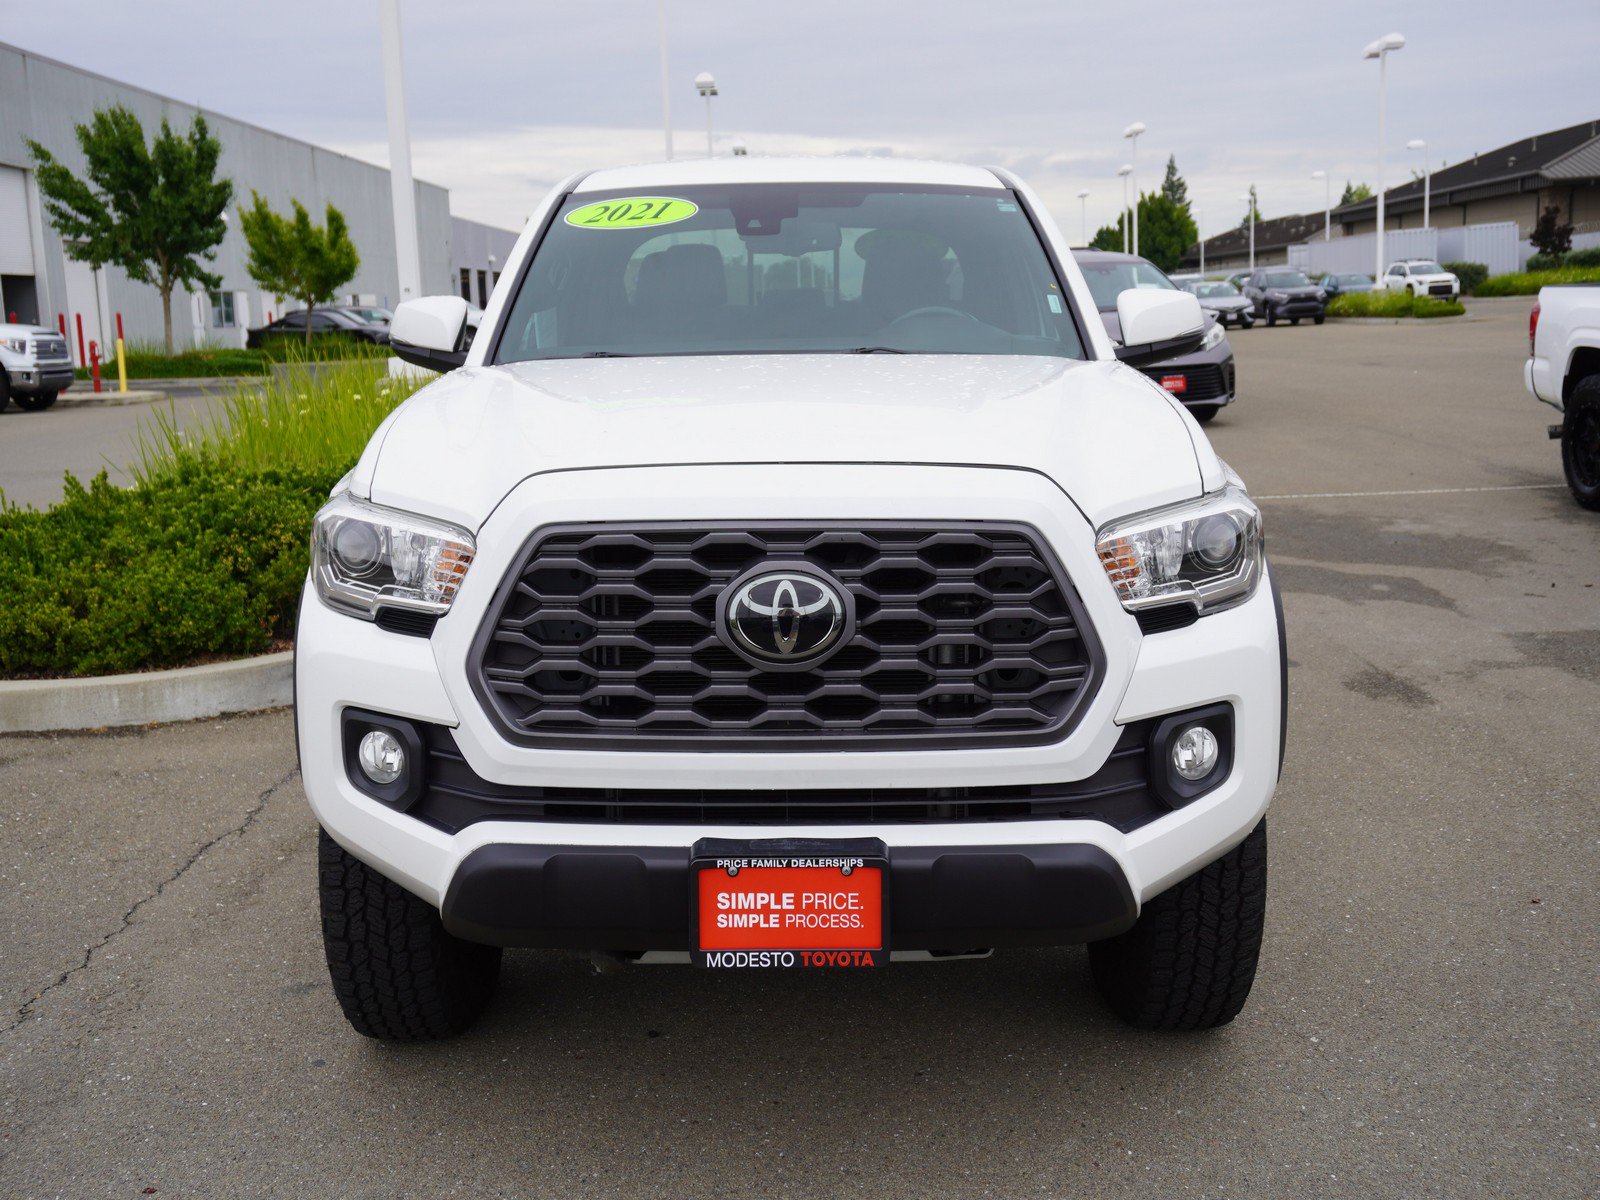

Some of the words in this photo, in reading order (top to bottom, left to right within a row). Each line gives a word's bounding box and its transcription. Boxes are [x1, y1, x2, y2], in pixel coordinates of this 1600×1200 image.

[583, 201, 673, 224] 2021
[716, 859, 748, 868] PRICE
[751, 859, 788, 868] FAMILY
[791, 858, 863, 867] DEALERSHIPS
[716, 892, 795, 910] SIMPLE
[802, 892, 864, 910] PRICE.
[716, 914, 780, 928] SIMPLE
[785, 914, 864, 928] PROCESS.
[706, 952, 795, 968] MODESTO
[800, 951, 874, 966] TOYOTA
